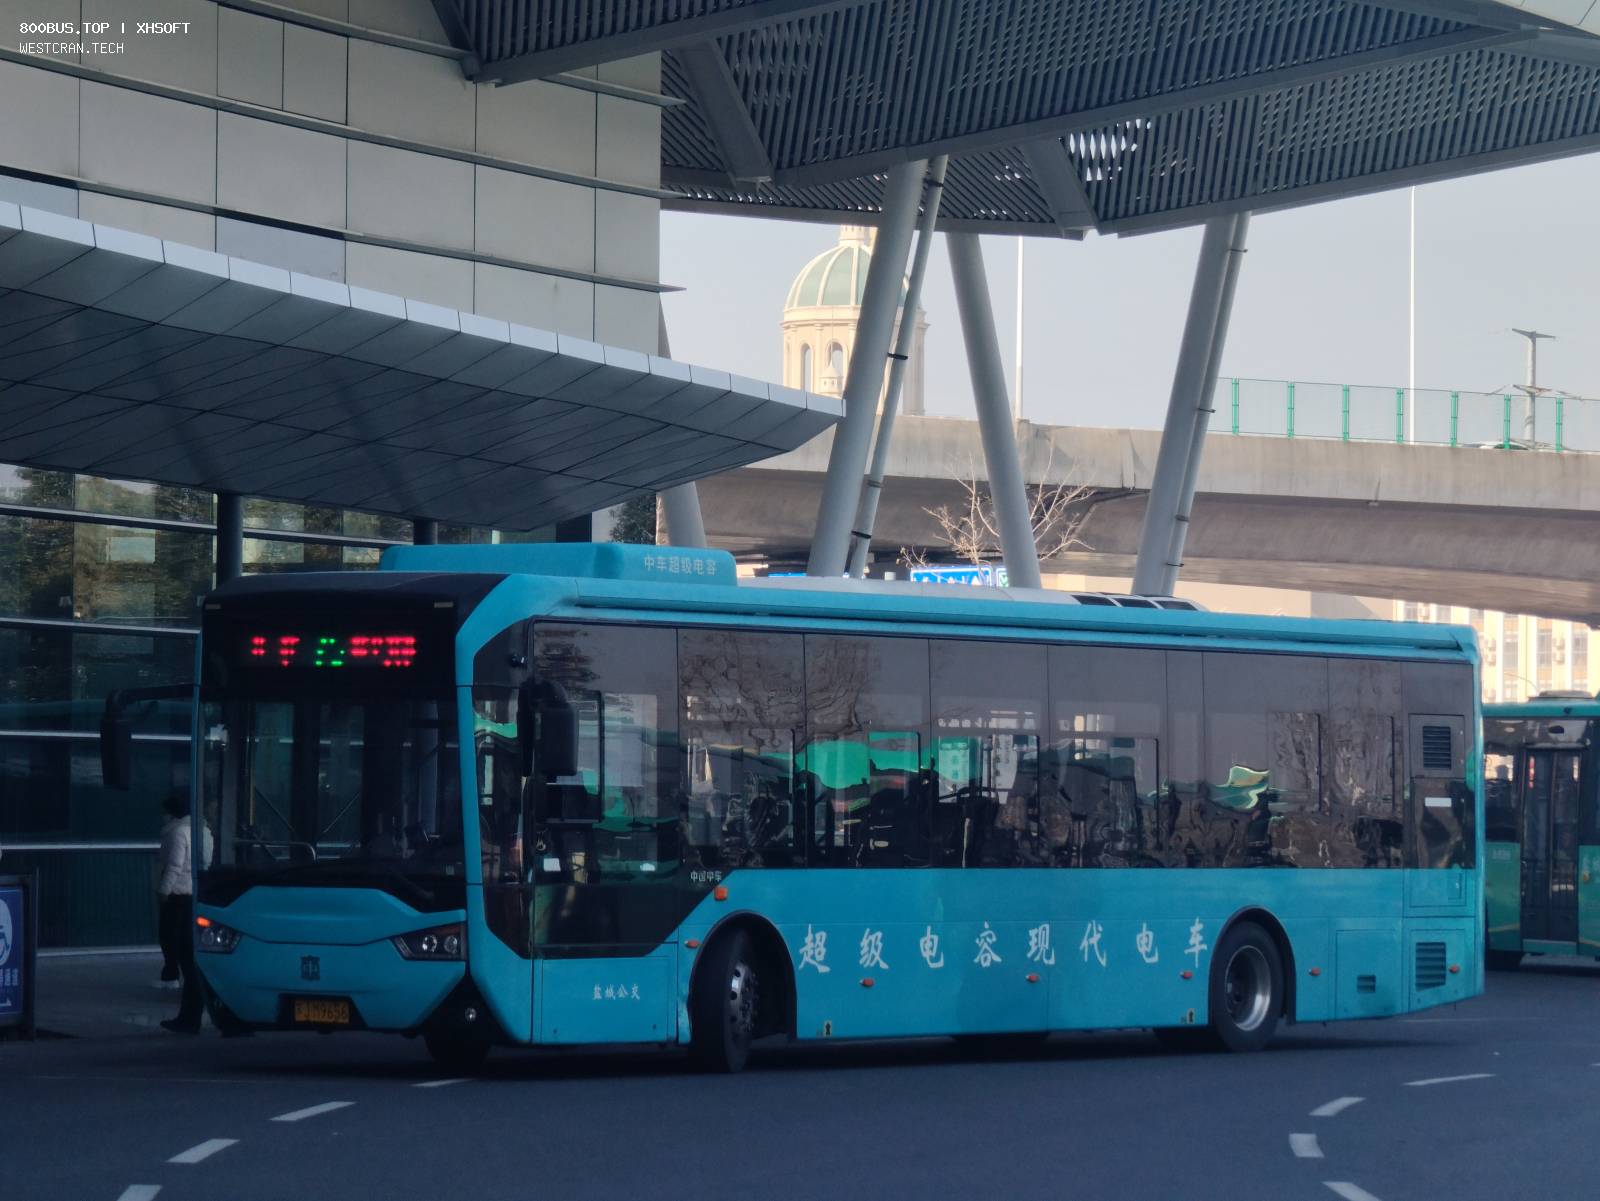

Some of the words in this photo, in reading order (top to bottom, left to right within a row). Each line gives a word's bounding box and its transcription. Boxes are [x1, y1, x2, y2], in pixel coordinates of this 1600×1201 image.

[644, 555, 716, 575] 中车超级电容
[798, 918, 1208, 973] 超级电容现代电车
[591, 983, 641, 1000] 盐城公交
